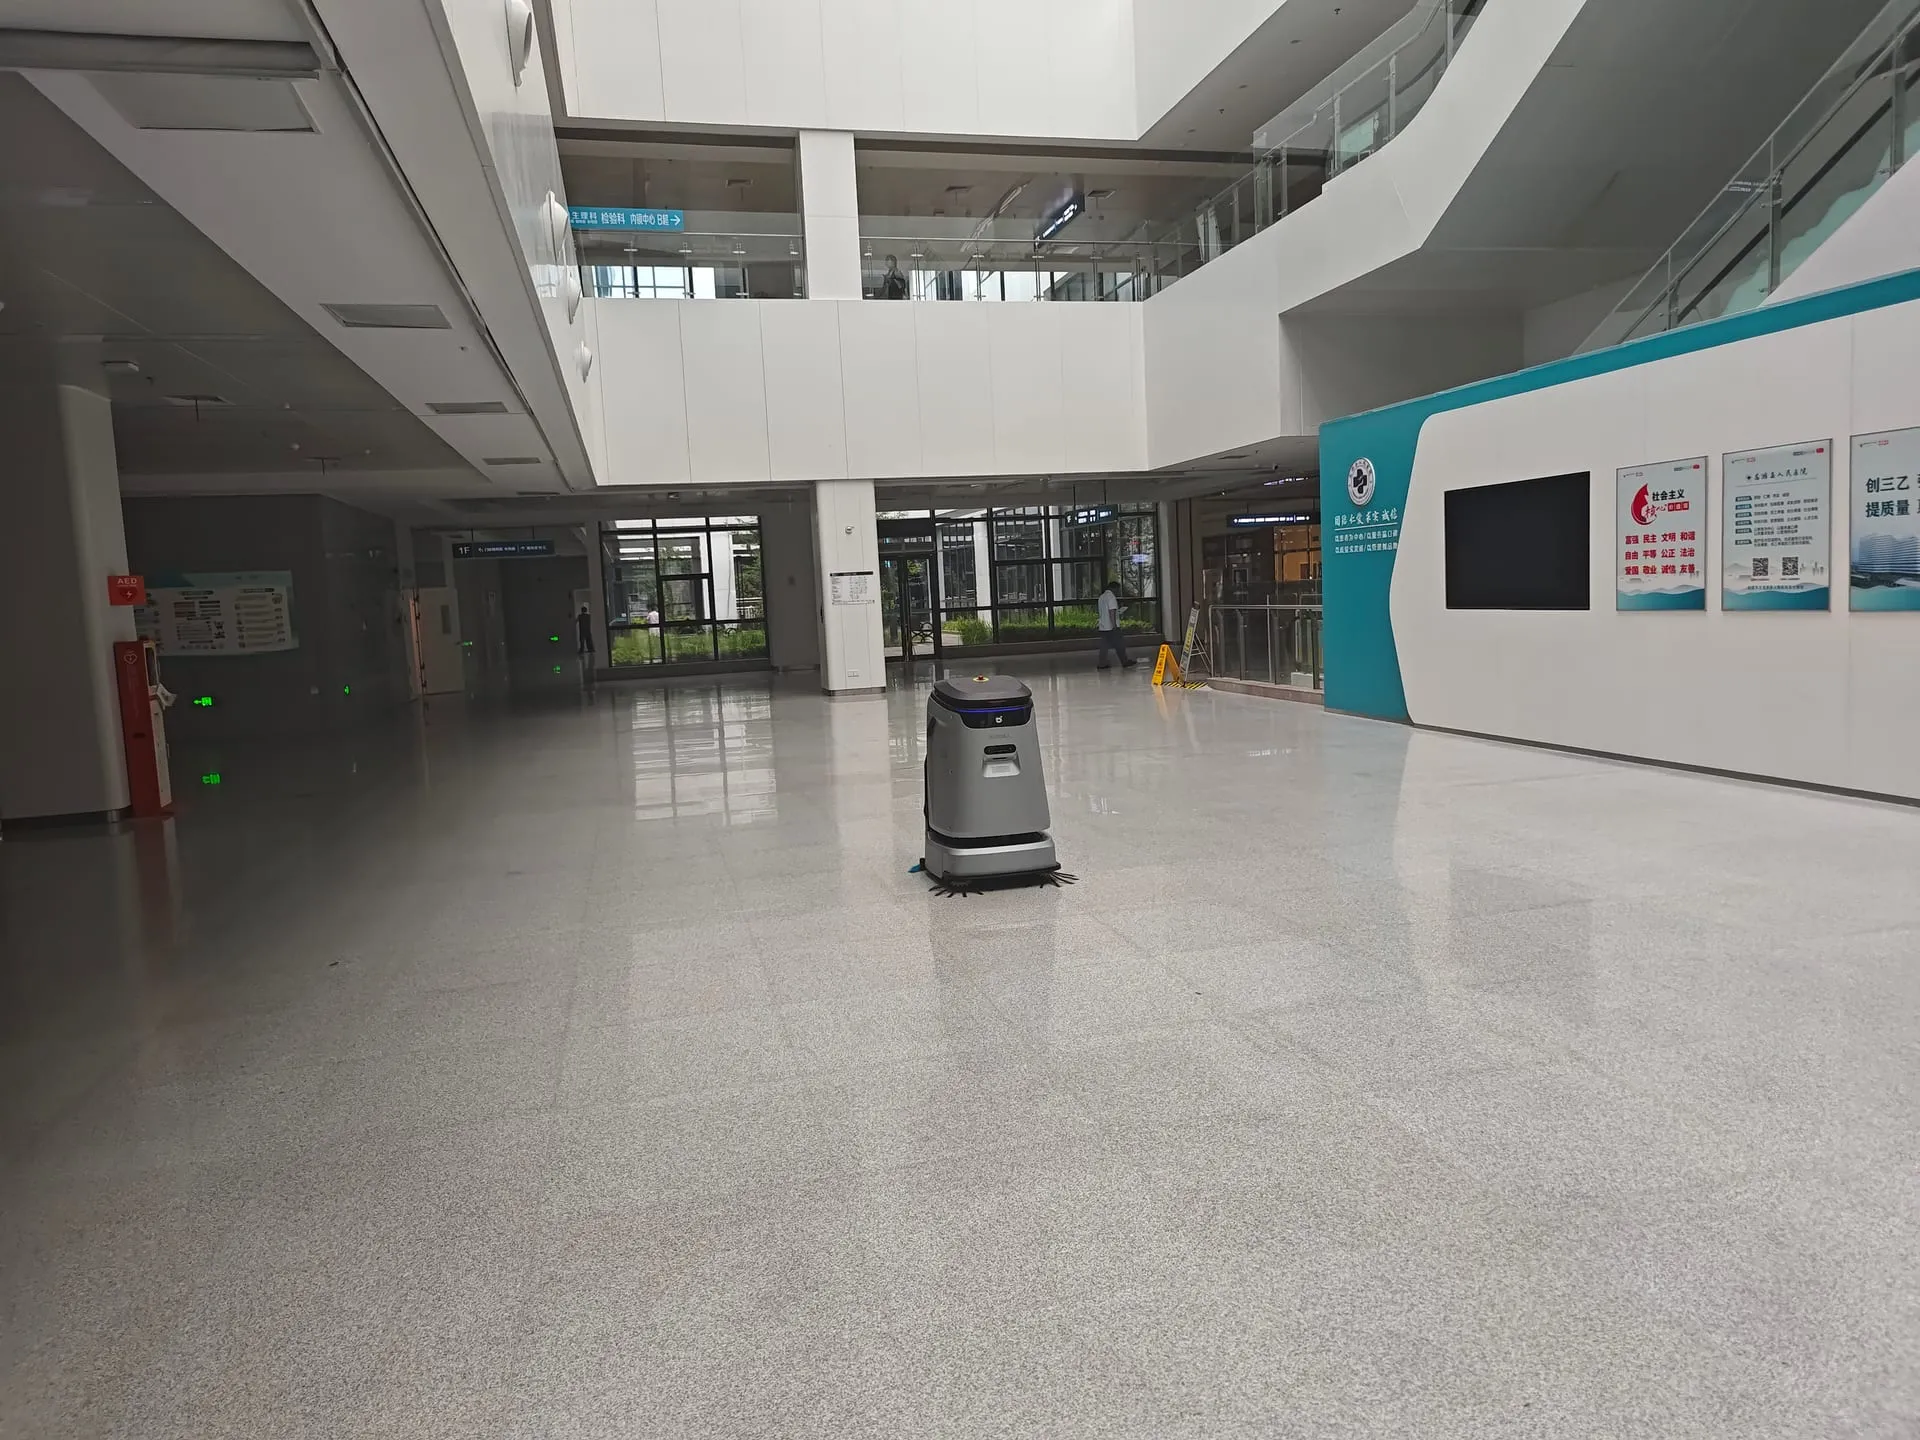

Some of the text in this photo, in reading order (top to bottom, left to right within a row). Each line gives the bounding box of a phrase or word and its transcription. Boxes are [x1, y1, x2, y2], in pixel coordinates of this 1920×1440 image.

[600, 212, 626, 225] 检验科
[1865, 475, 1910, 493] 创三乙
[1652, 489, 1685, 501] 社会主义
[1865, 499, 1911, 518] 提质量
[1643, 533, 1657, 544] 民主
[1661, 532, 1676, 542] 文明
[1625, 547, 1695, 560] 自由 平等 公正 法治
[1642, 564, 1657, 575] 敬业
[1679, 563, 1695, 574] 友善
[117, 577, 137, 585] AED
